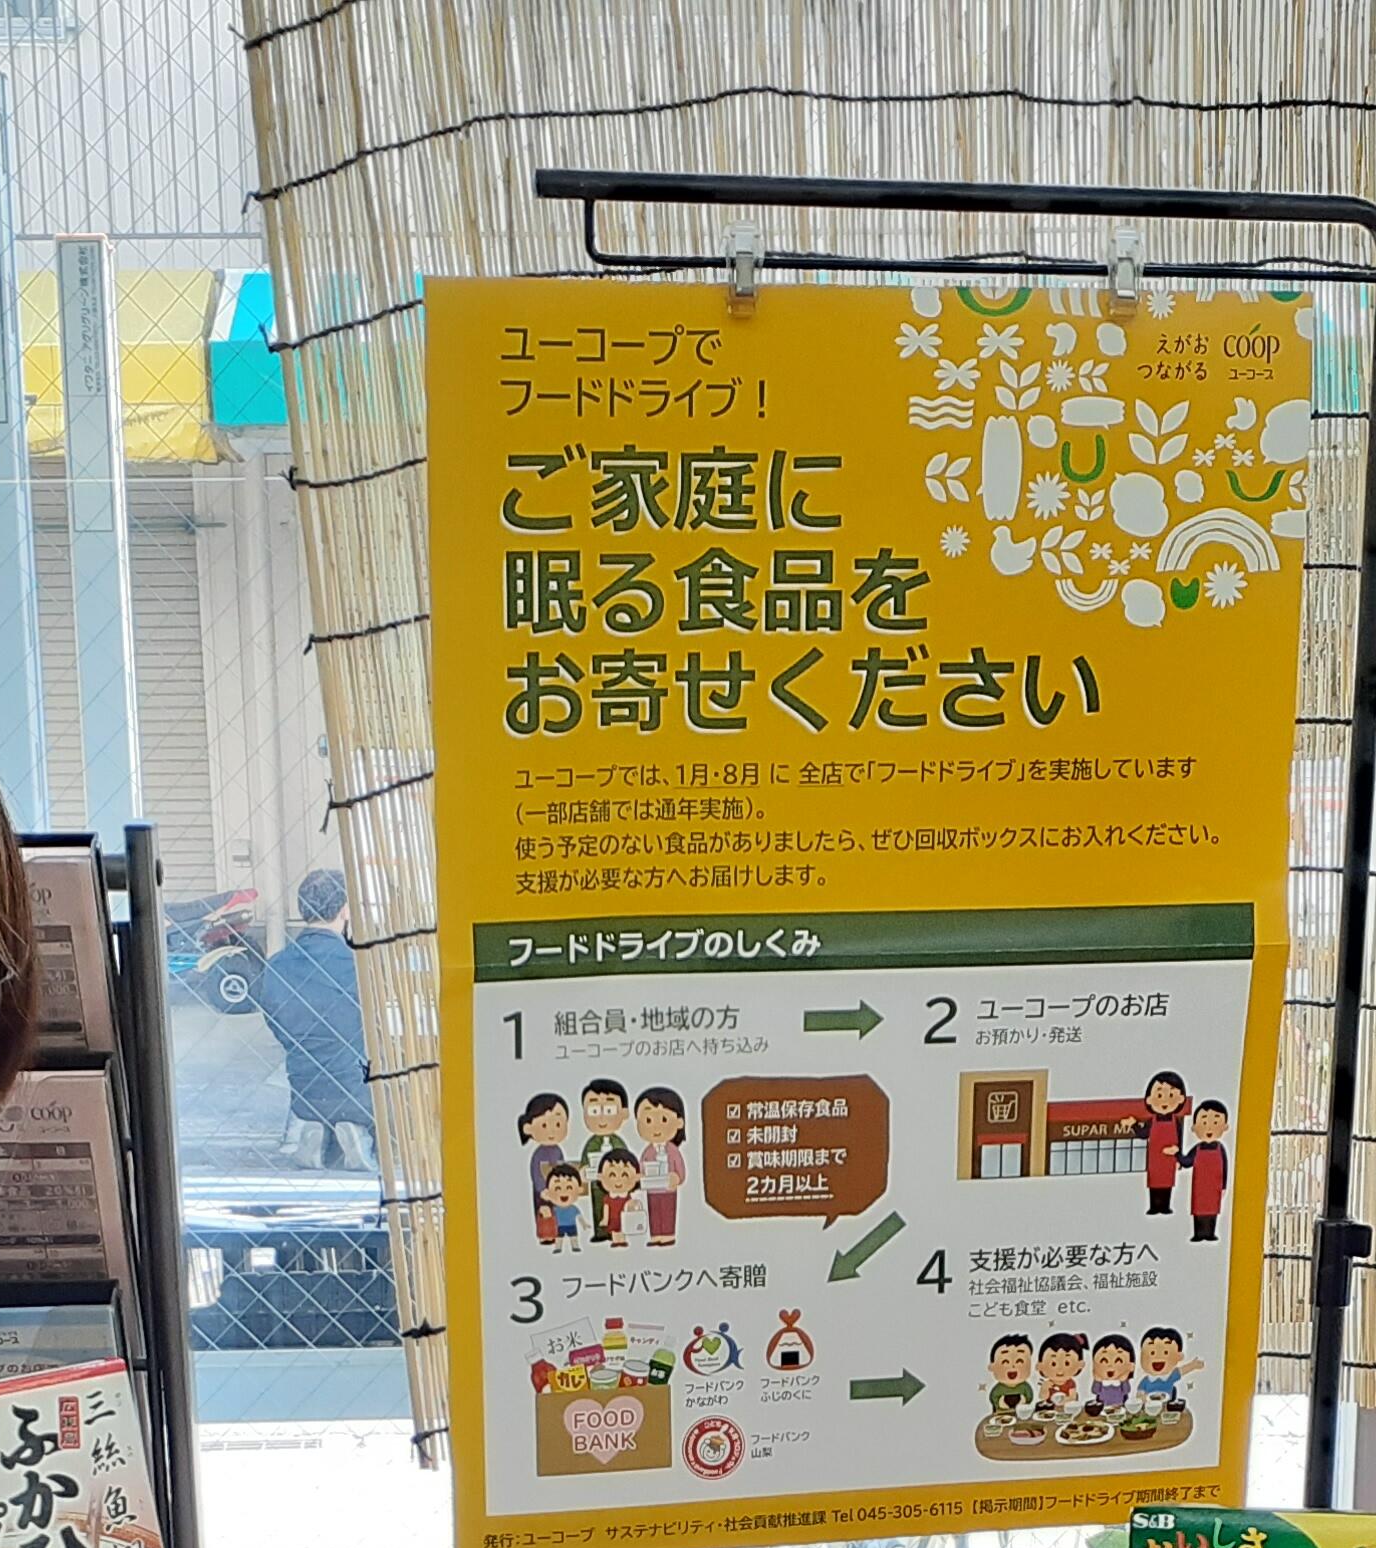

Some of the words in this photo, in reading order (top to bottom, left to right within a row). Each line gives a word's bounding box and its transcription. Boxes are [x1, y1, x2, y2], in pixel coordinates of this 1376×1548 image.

[500, 325, 723, 365] ユーコープで
[1156, 333, 1209, 354] えがお
[1137, 361, 1207, 380] つながる
[501, 376, 768, 418] フードドライブ！
[502, 447, 842, 533] ご家庭に
[503, 547, 931, 634] 眠る食品を
[503, 646, 1102, 736] お寄せください
[514, 862, 828, 892] 支援が必要な方へお届けします。
[507, 931, 822, 965] フードドライブのしくみ
[503, 1010, 525, 1060] 1
[553, 1006, 740, 1035] 組合員・地域の方
[923, 998, 958, 1045] 2
[975, 992, 1170, 1022] ユーコープのお店
[975, 1024, 1083, 1047] お預かり・発送
[746, 1098, 849, 1121] 常温保存食品
[746, 1124, 798, 1145] 未開封
[1063, 1124, 1108, 1137] SUPAR
[746, 1148, 847, 1171] 賞味期限まで
[916, 1249, 952, 1295] 4
[968, 1243, 1160, 1273] 支援が必要な方へ
[510, 1276, 544, 1324] 3
[562, 1264, 767, 1299] フードバンクへ寄贈
[968, 1300, 1047, 1318] こども食堂
[1058, 1299, 1091, 1315] etc.
[547, 1331, 583, 1355] お米
[684, 1380, 744, 1394] フードバンク
[760, 1375, 820, 1388] フードバンク
[574, 1409, 635, 1431] FOOD
[574, 1430, 637, 1451] BANK
[750, 1430, 810, 1444] フードバンク
[831, 1506, 855, 1523] Tel
[857, 1500, 965, 1521] 045-305-6115
[1132, 1513, 1175, 1529] S&B
